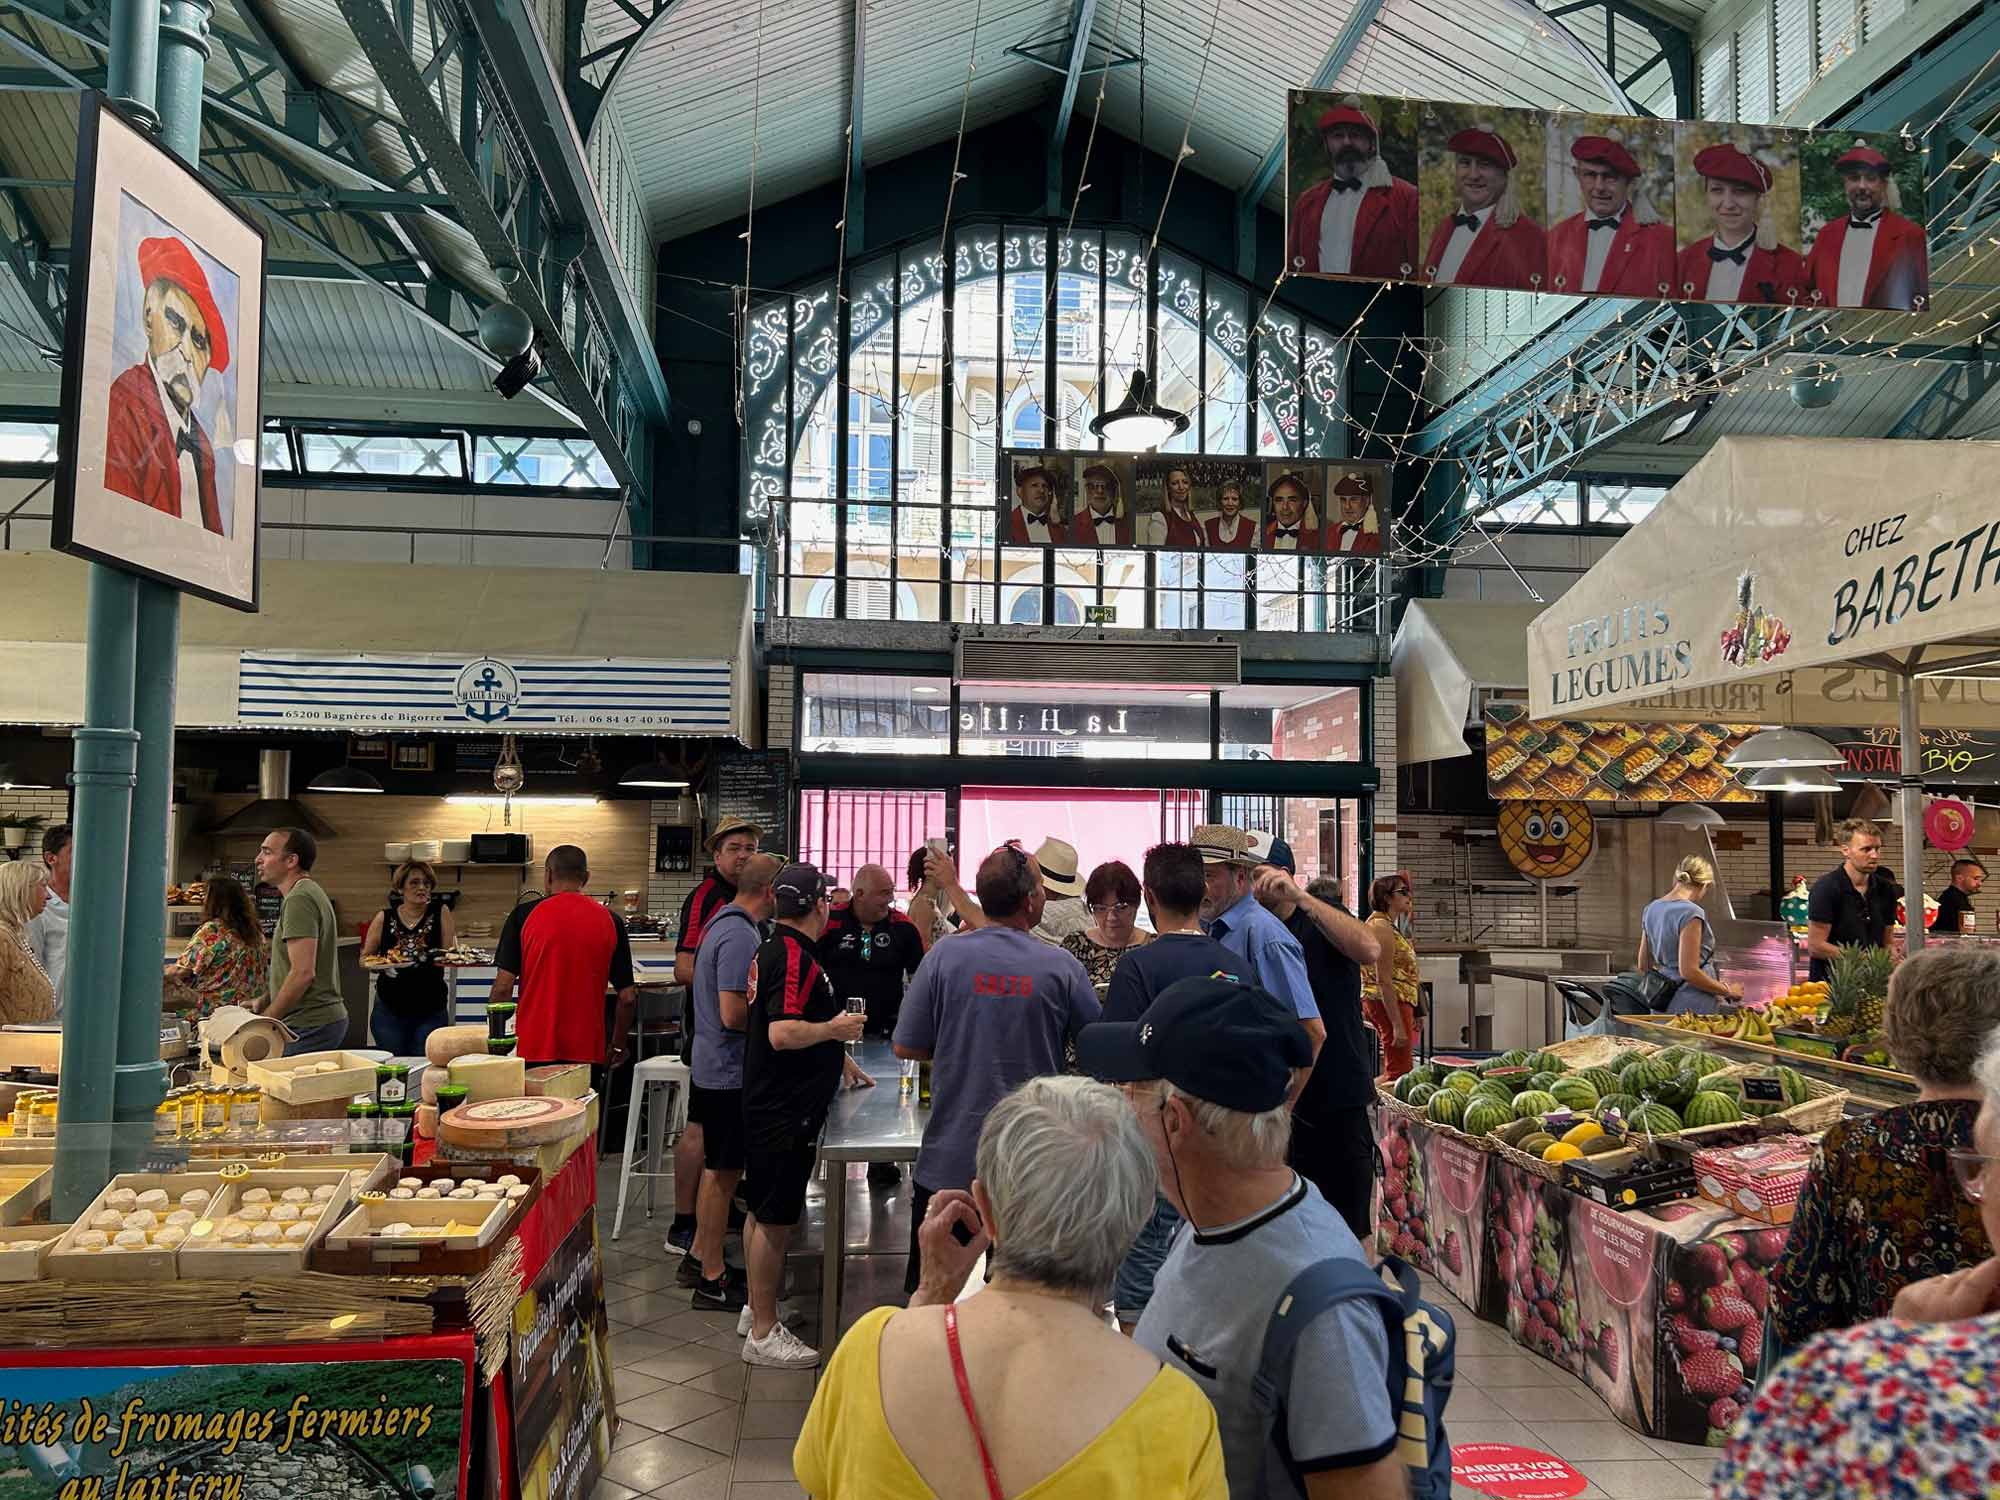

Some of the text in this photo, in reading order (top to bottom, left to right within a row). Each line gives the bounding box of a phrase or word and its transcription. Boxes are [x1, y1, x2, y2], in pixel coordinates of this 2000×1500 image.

[1845, 514, 1907, 557] CHEZ
[1567, 601, 1670, 659] FRUITS
[1552, 640, 1692, 705] LEGUMES
[285, 711, 442, 723] 65200 Bagnères de Bigorre
[589, 715, 602, 723] 06
[624, 715, 637, 723] 47
[640, 716, 653, 724] 40
[1603, 1245, 1631, 1269] ROUGES
[1607, 1231, 1619, 1247] LES
[1619, 1237, 1643, 1259] FRUITS
[74, 1399, 109, 1443] de
[111, 1398, 277, 1457] fromages
[277, 1394, 435, 1453] fermiers
[59, 1460, 244, 1500] au lait cru
[1451, 1460, 1564, 1475] GARDEZ VOS
[1467, 1470, 1569, 1484] DISTANCES
